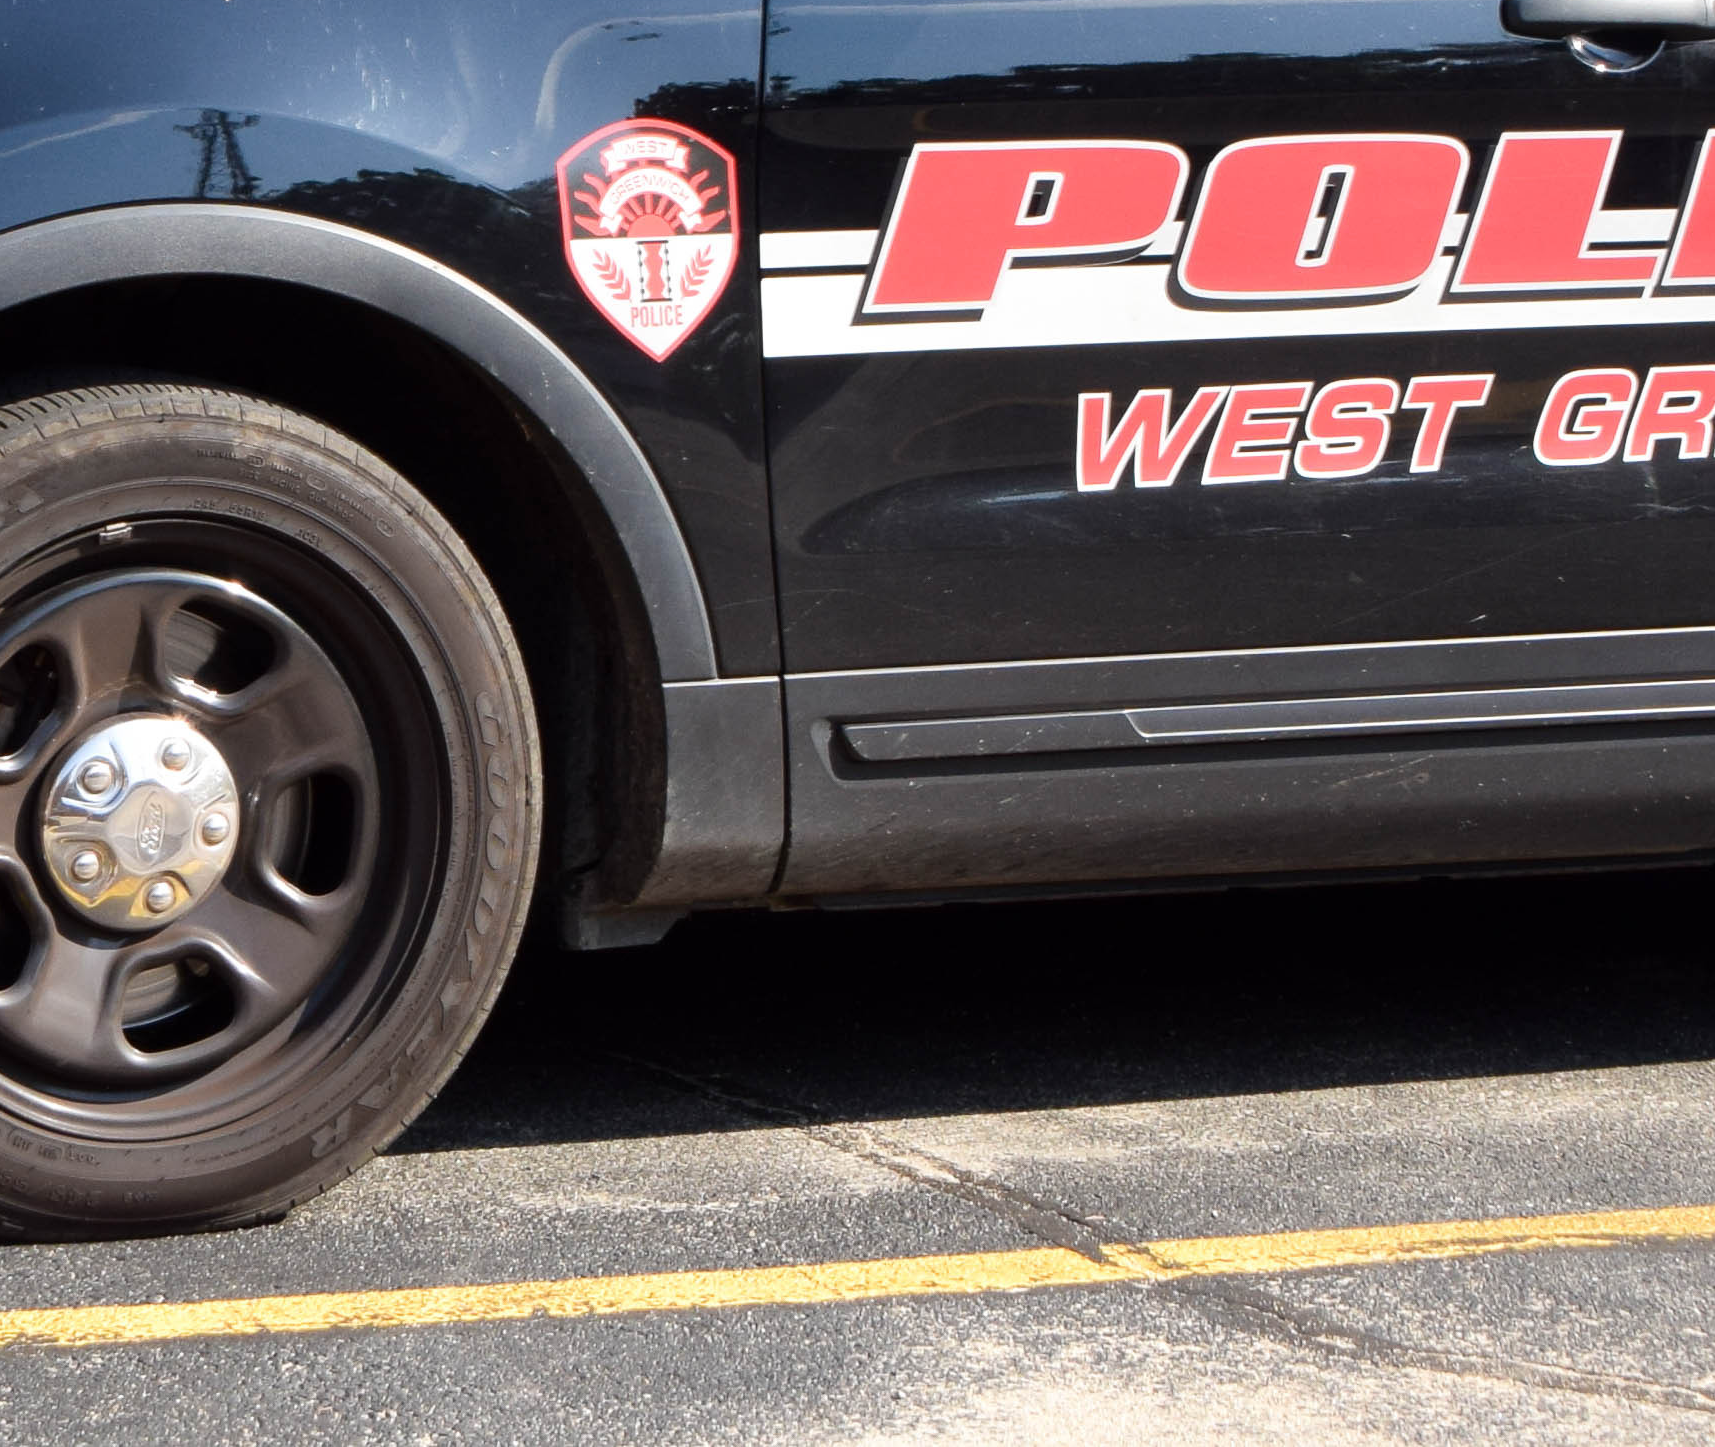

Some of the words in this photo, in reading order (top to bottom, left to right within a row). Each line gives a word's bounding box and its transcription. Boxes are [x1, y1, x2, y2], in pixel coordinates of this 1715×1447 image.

[617, 140, 669, 155] WEST
[611, 173, 690, 206] GREENWICH
[629, 304, 684, 329] POLICE
[1073, 371, 1496, 491] WEST
